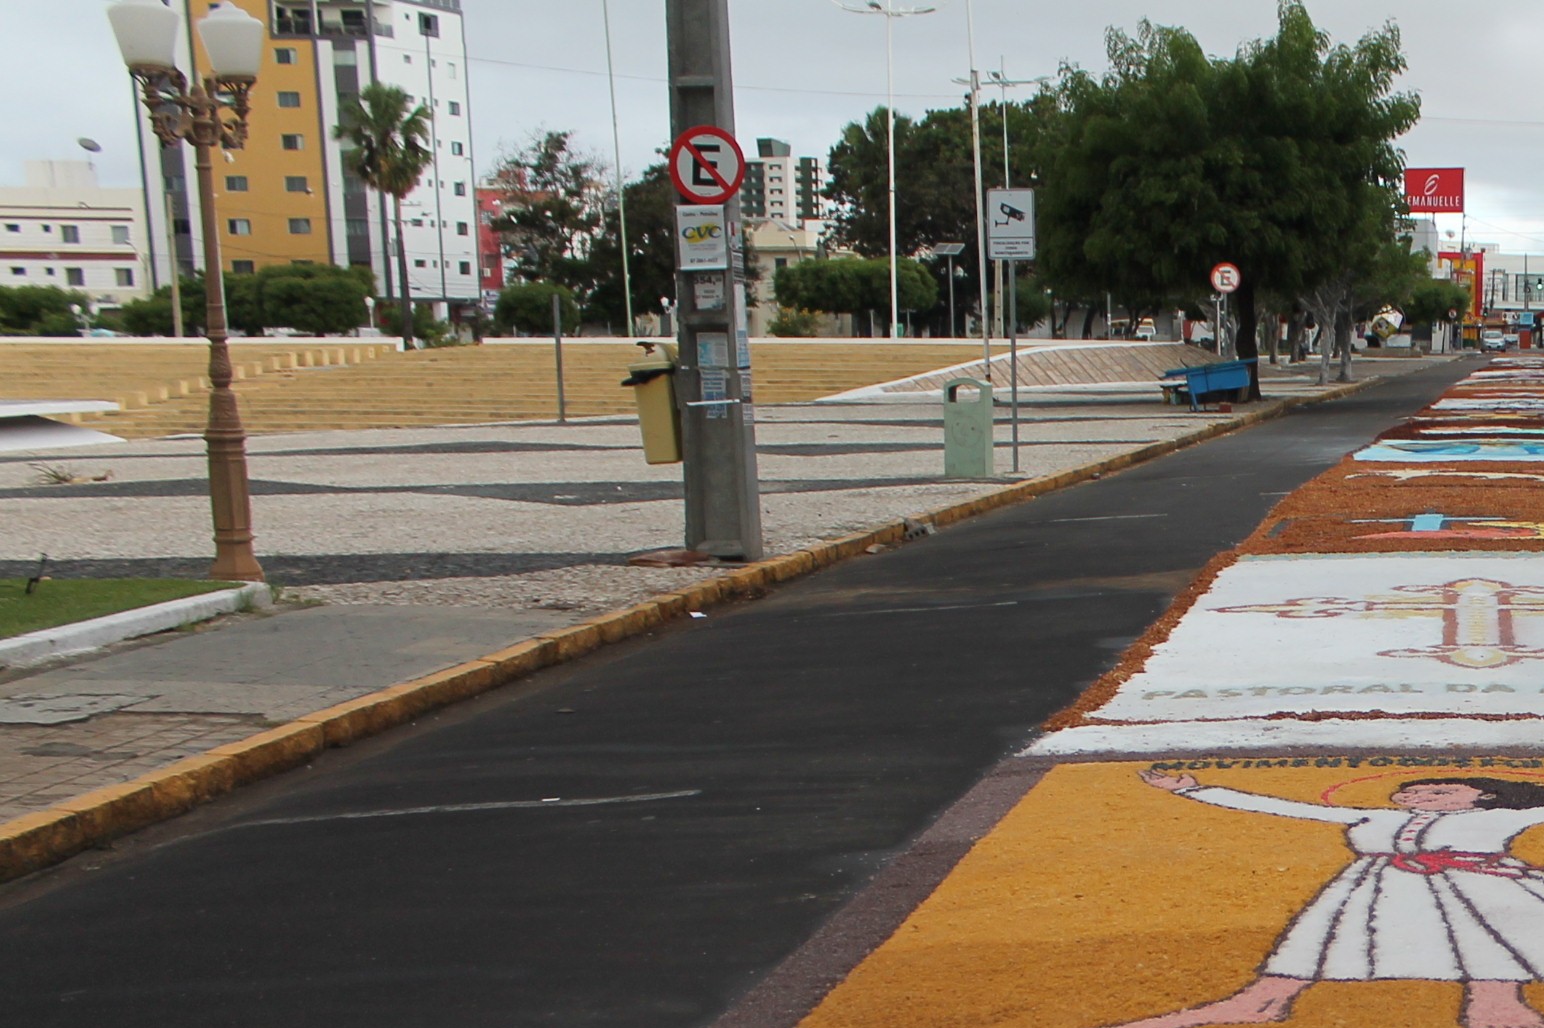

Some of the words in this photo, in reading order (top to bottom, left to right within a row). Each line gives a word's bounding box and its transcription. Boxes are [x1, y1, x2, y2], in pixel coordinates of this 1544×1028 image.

[1407, 195, 1460, 207] EMANUELLE
[682, 226, 722, 239] CVC
[1142, 683, 1423, 701] PASTORAL
[1446, 684, 1516, 693] DA
[1151, 757, 1393, 771] MOVIMENTO
